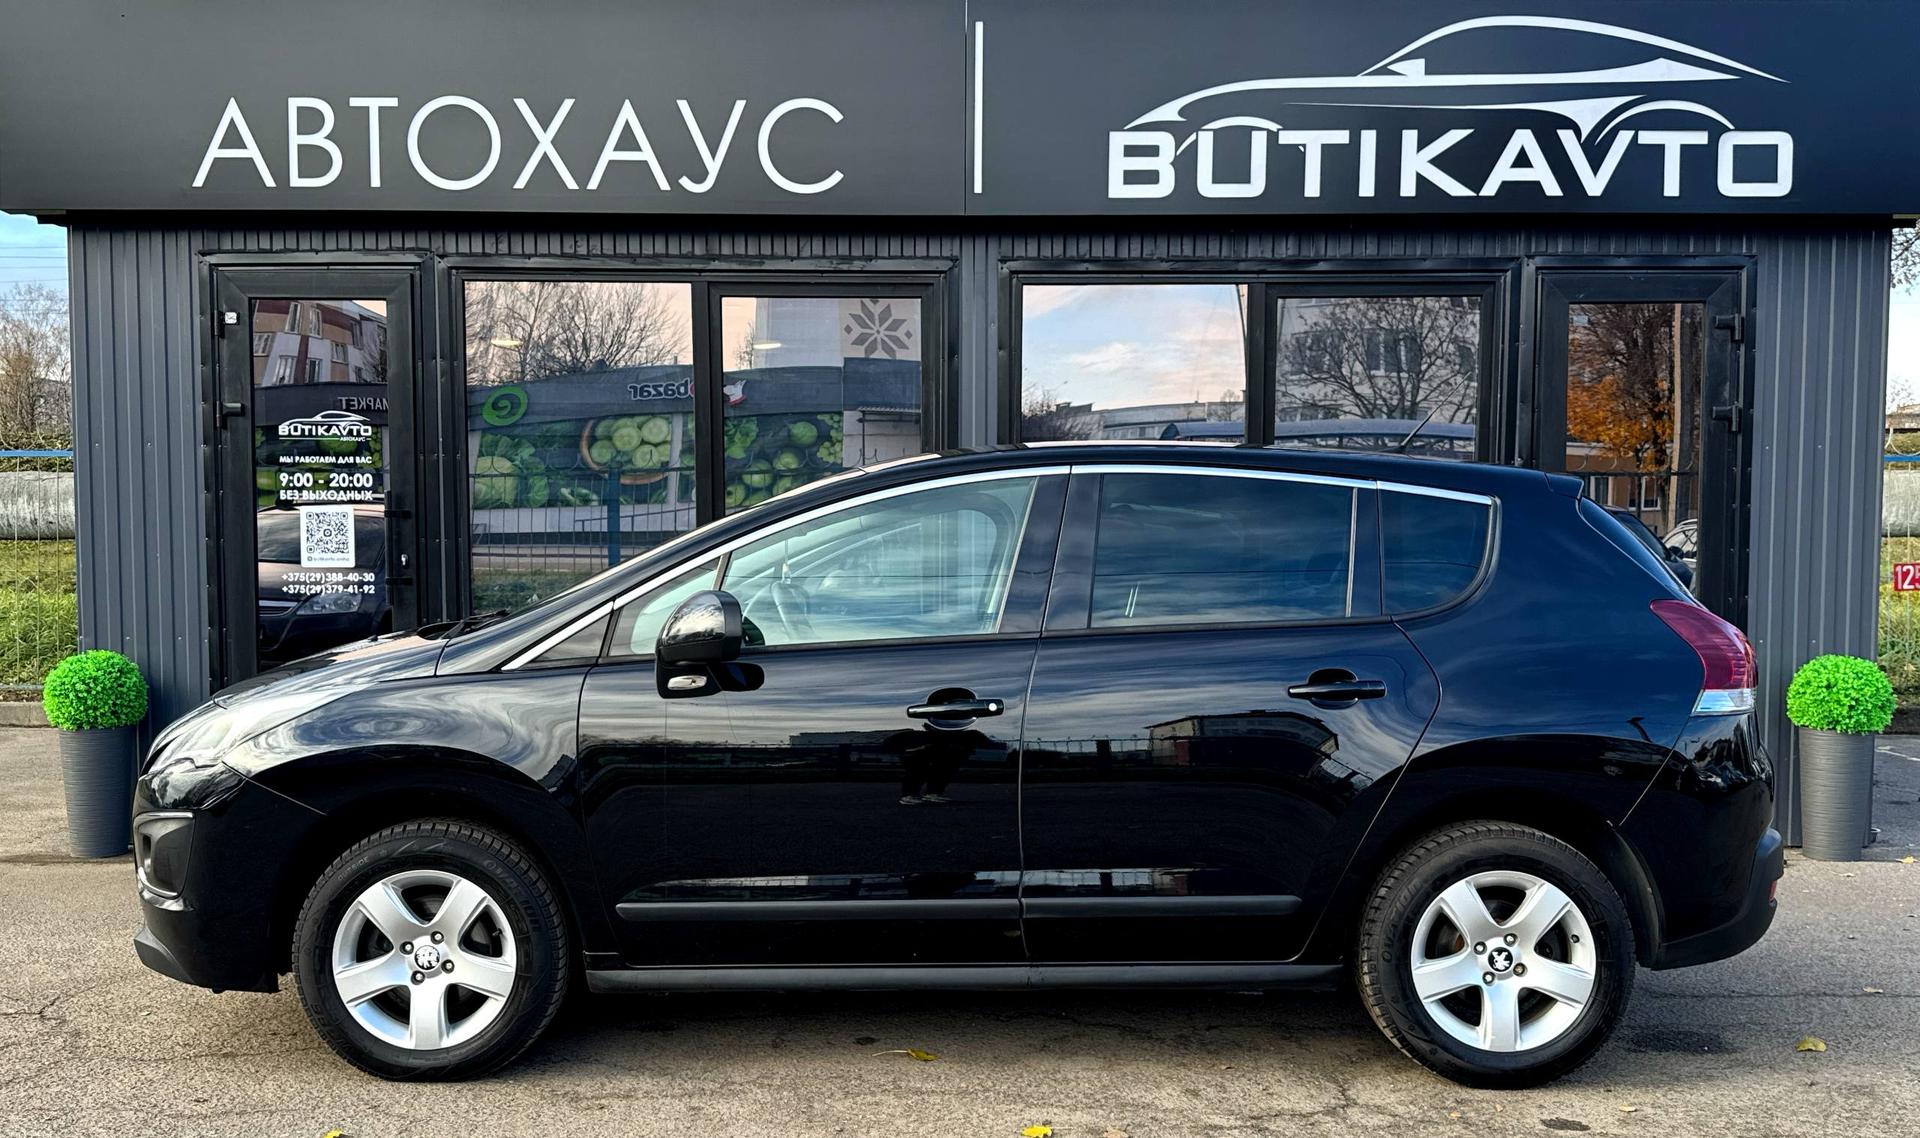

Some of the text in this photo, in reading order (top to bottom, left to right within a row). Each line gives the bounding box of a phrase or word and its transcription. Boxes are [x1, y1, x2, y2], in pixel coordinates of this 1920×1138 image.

[191, 95, 846, 195] АВТОХАУС
[1108, 128, 1794, 199] BUTIKAVTO
[278, 425, 372, 436] BUTIKAVTO
[279, 455, 373, 464] МЫ РАБОТАЕМ ДЛЯ ВАС
[279, 472, 313, 487] 9:00
[329, 472, 373, 487] 20:00
[279, 489, 373, 501] БЕЗ ВЫХОДНЫХ
[282, 572, 375, 583] +375(29)388-40-30
[282, 585, 375, 596] +375(29)379-41-92
